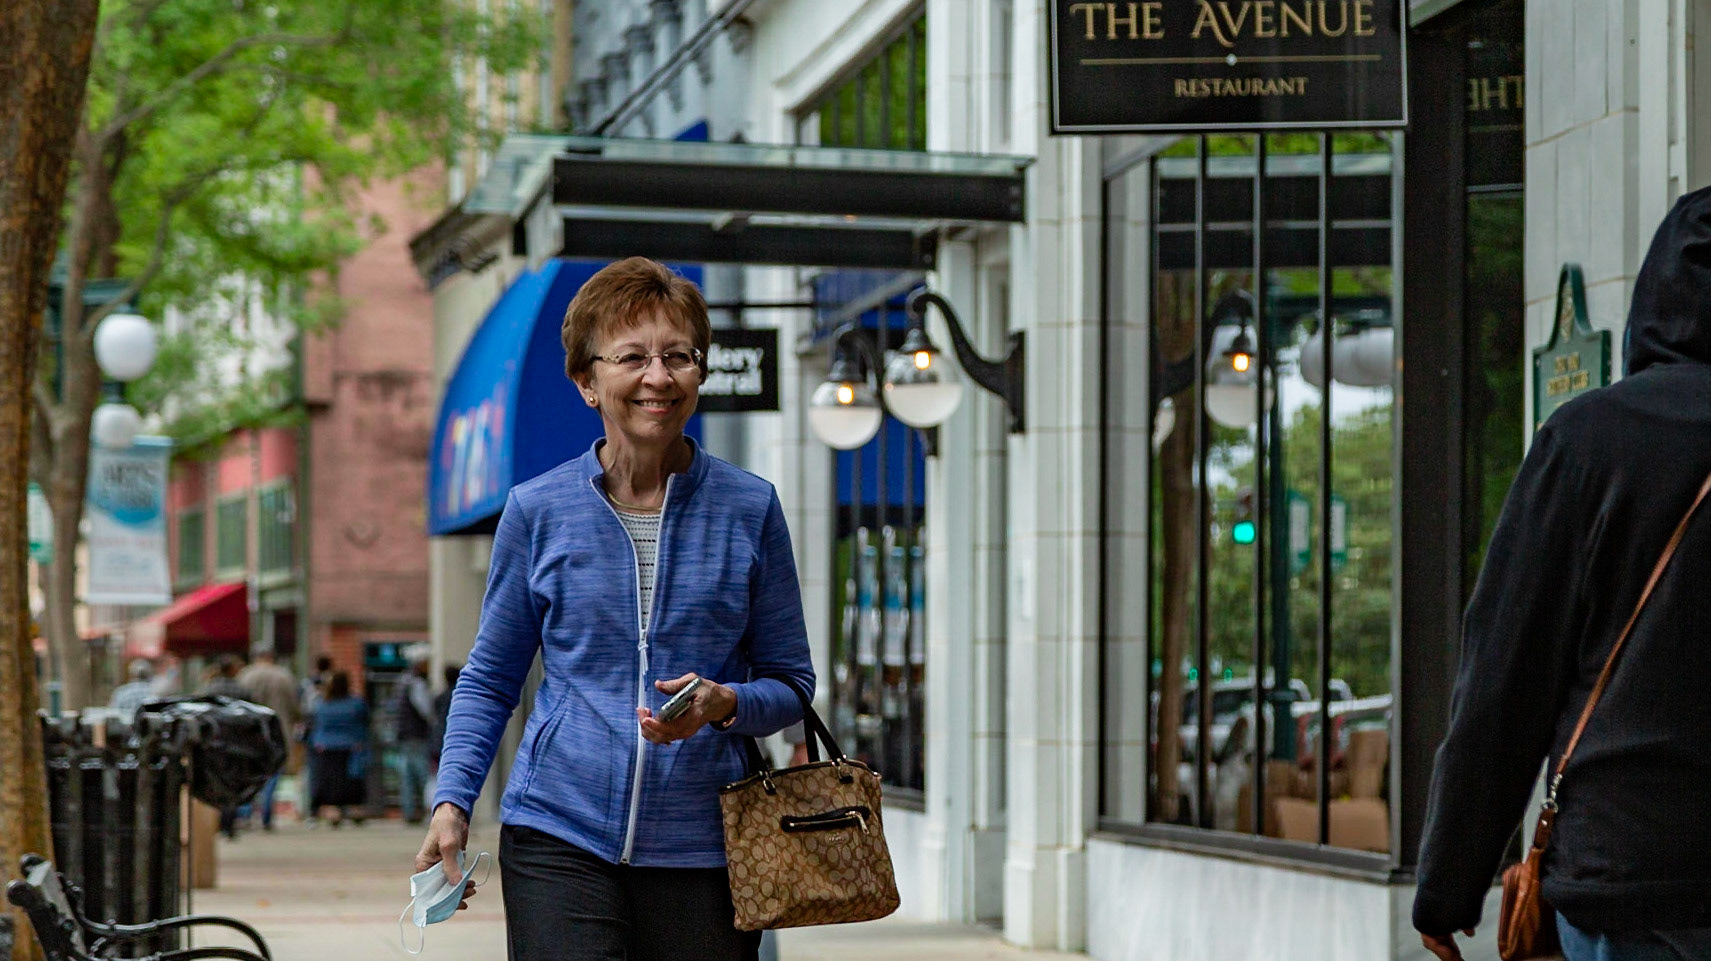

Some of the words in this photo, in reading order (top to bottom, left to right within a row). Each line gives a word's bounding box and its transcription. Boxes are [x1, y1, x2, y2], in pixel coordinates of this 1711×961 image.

[1069, 1, 1165, 40] THE
[1191, 0, 1377, 48] AVENUE
[1174, 76, 1309, 98] RESTAURANT
